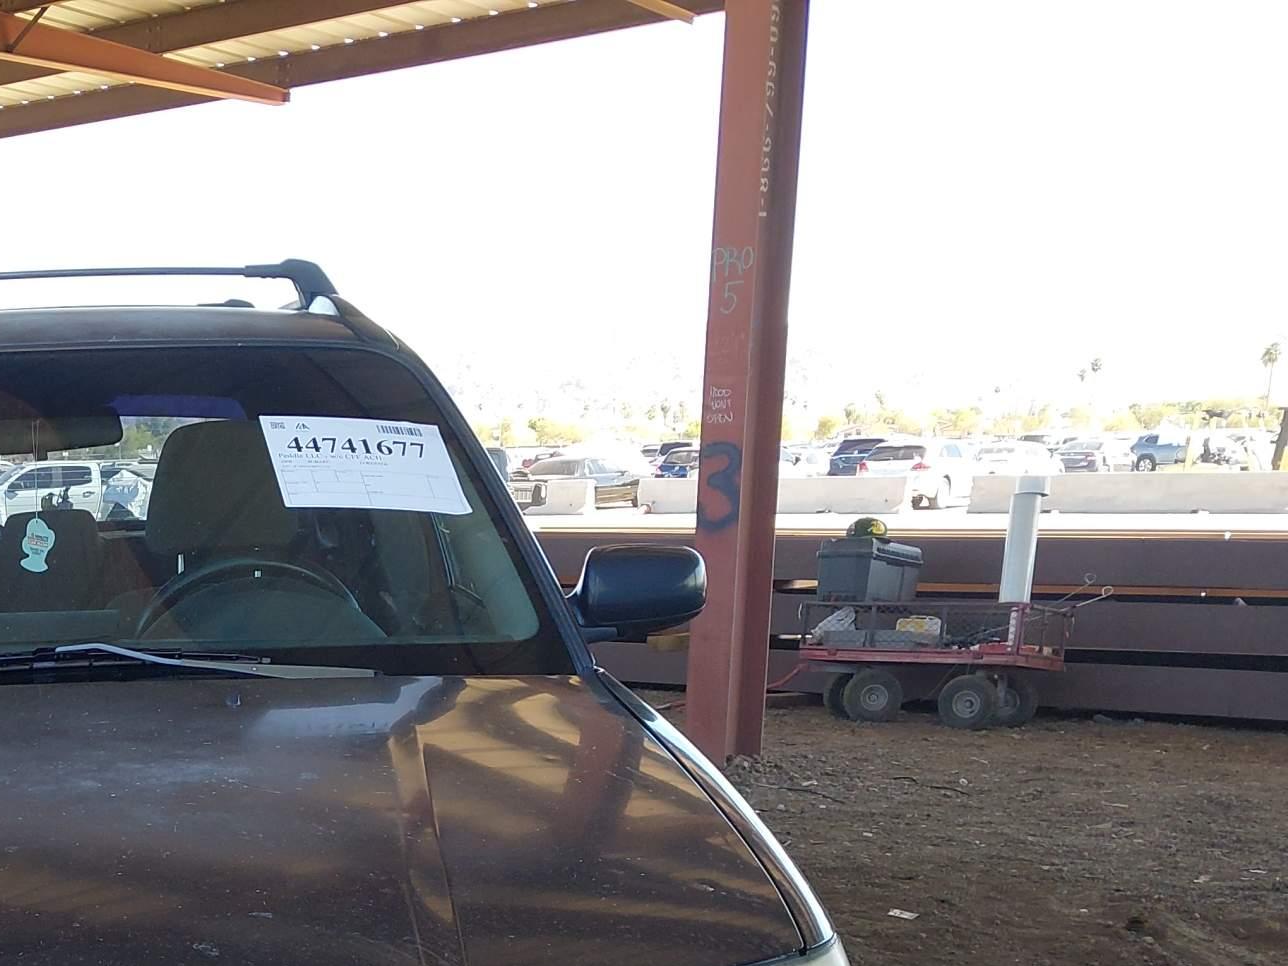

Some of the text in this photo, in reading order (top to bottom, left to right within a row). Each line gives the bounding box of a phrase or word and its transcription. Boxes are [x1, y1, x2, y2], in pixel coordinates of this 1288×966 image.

[758, 0, 781, 217] 1-866-799-09
[711, 246, 754, 283] PRO
[719, 280, 745, 315] 5
[287, 436, 425, 459] 44741677
[695, 441, 741, 535] 3
